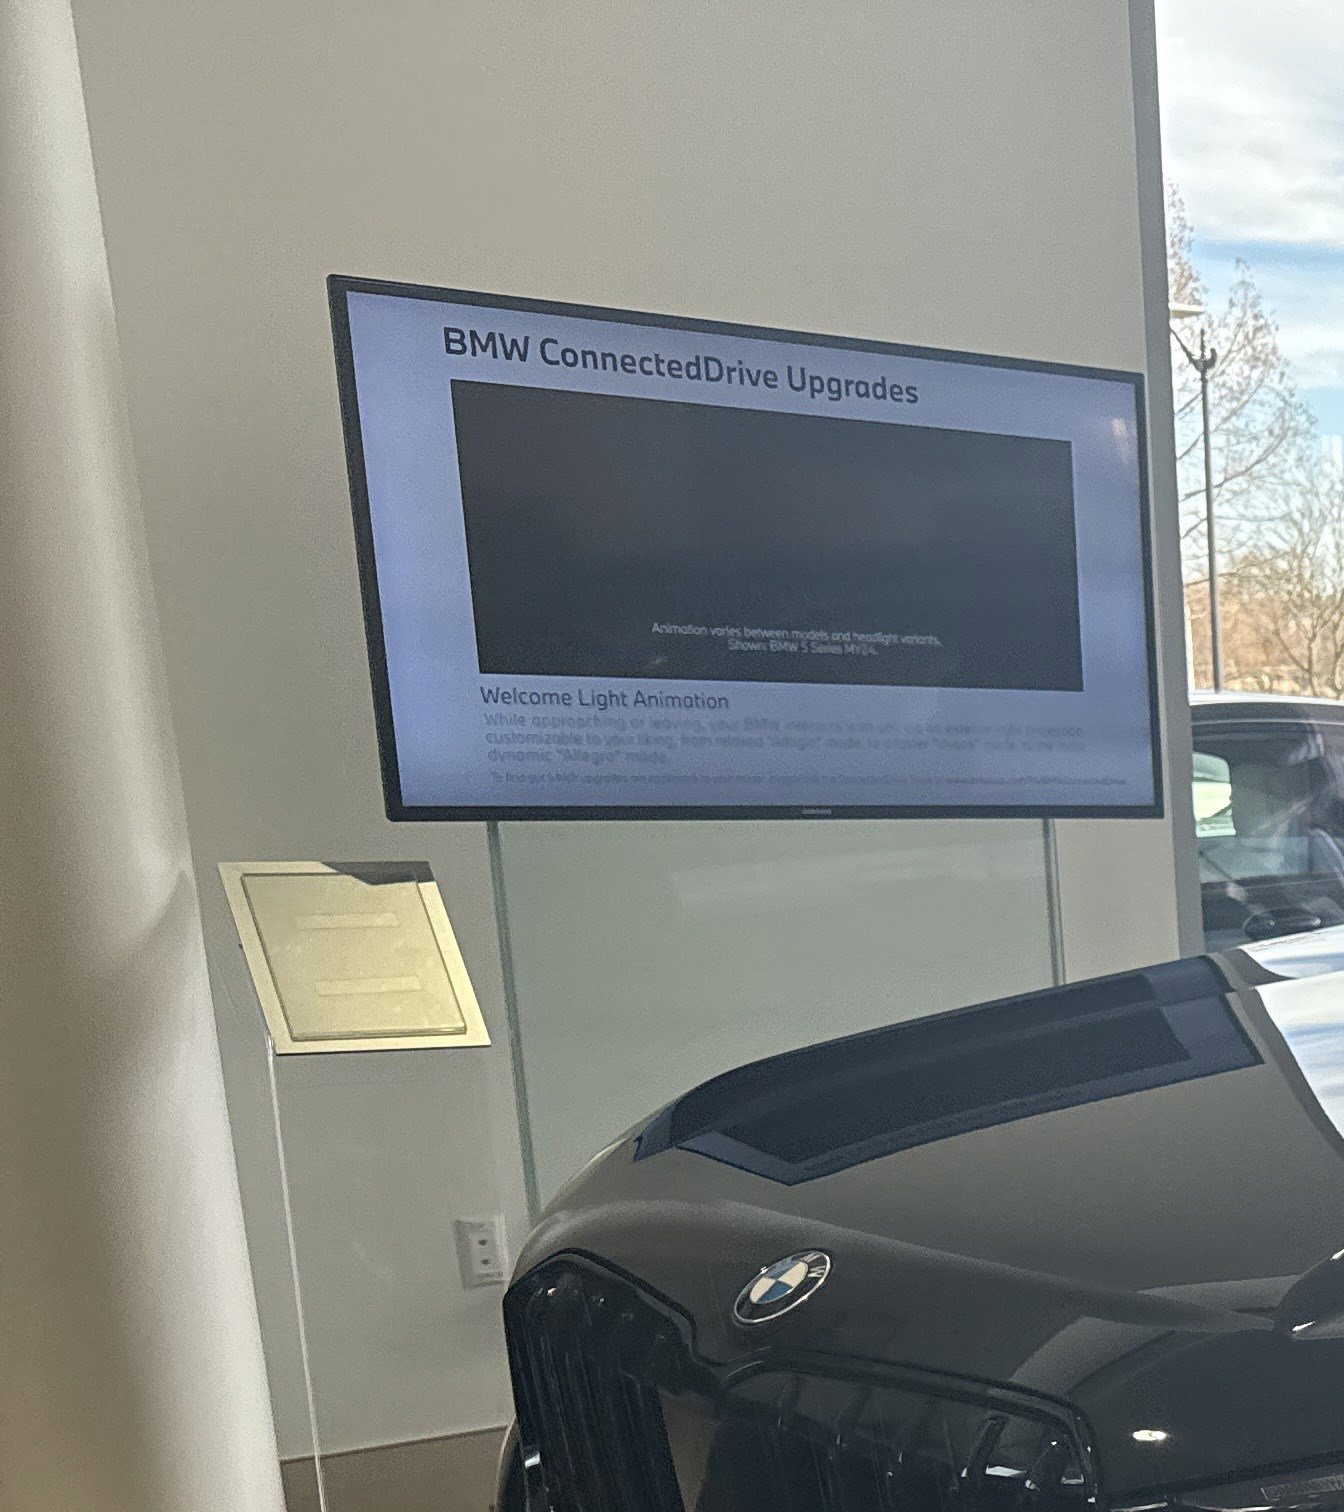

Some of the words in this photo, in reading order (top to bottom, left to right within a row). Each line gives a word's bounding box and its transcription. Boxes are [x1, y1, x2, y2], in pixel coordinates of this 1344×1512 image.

[443, 326, 530, 362] BMW
[539, 337, 779, 388] ConnectedDrive
[787, 365, 919, 404] Upgrades
[651, 621, 707, 636] Animation
[743, 626, 789, 638] between
[831, 631, 850, 641] and
[769, 639, 798, 653] BMW
[480, 686, 573, 707] Welcome
[577, 689, 628, 711] Light
[633, 690, 730, 709] Animation
[484, 713, 526, 727] While
[532, 715, 627, 732] approaching
[485, 731, 583, 746] customizable
